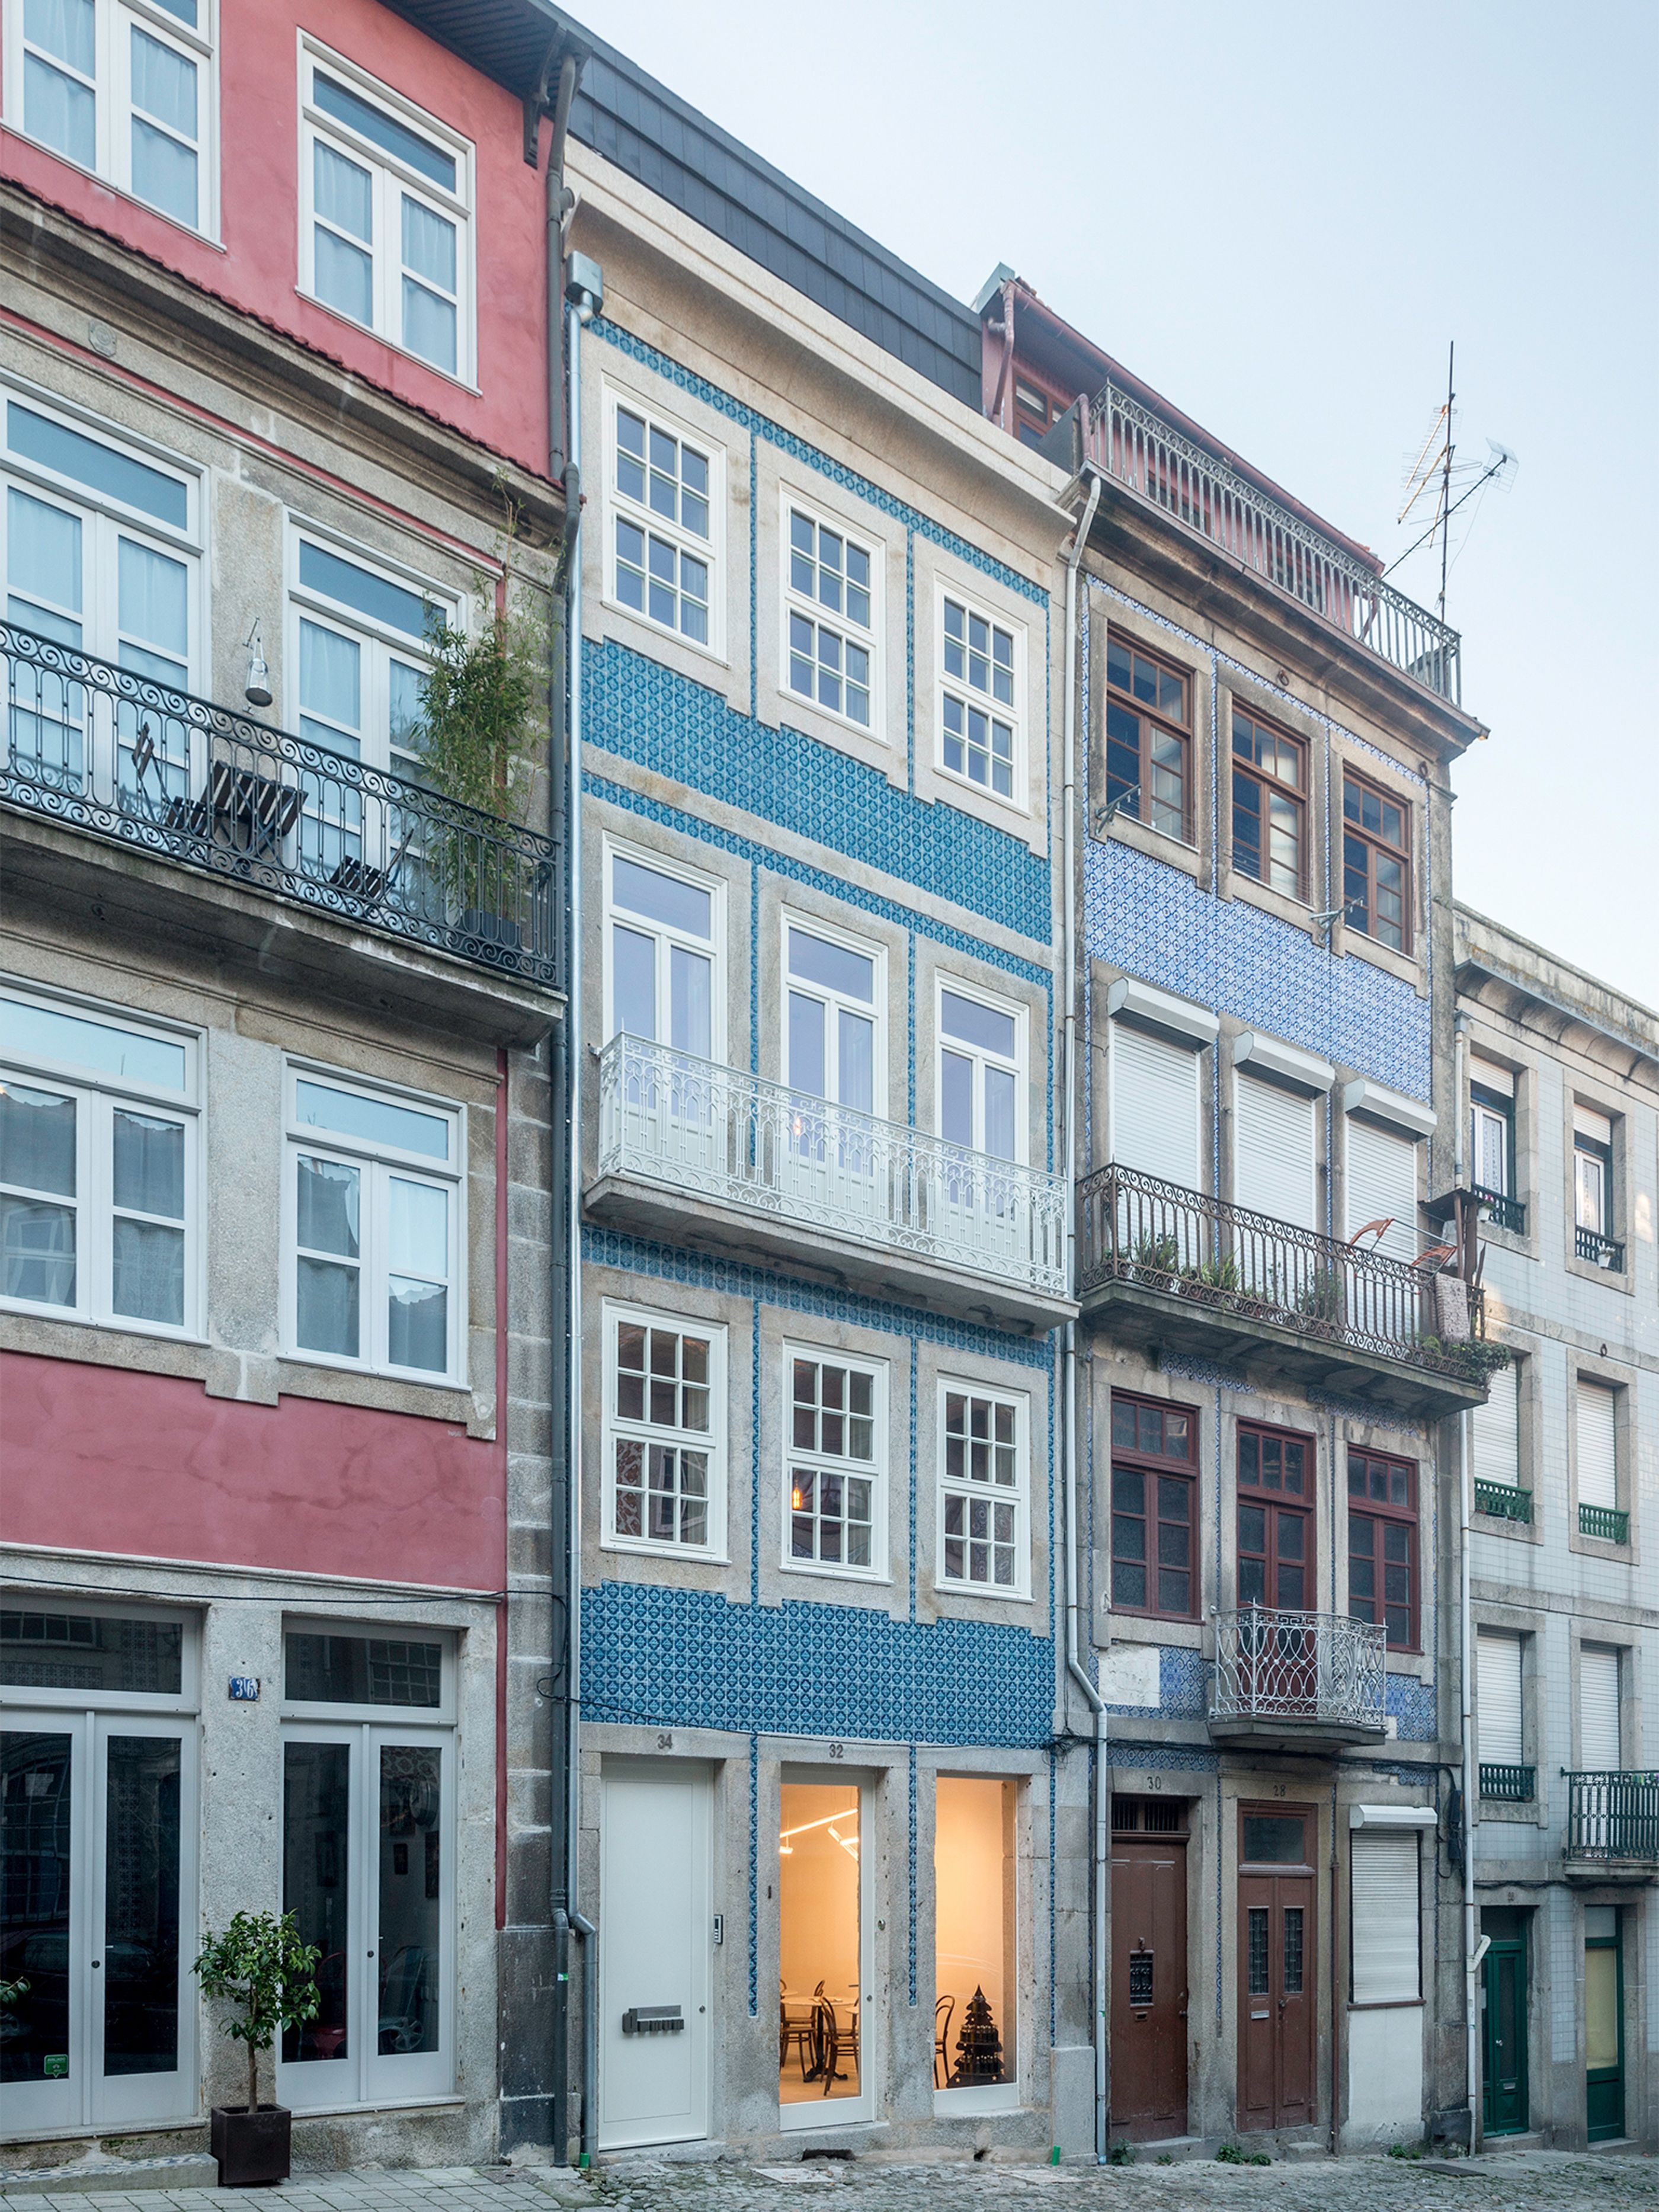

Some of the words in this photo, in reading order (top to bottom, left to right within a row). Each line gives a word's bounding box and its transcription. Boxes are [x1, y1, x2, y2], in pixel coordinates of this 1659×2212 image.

[236, 1679, 254, 1698] 36
[657, 1733, 673, 1749] 34
[829, 1743, 844, 1758] 32
[1146, 1775, 1162, 1790] 30
[1273, 1784, 1286, 1797] 28
